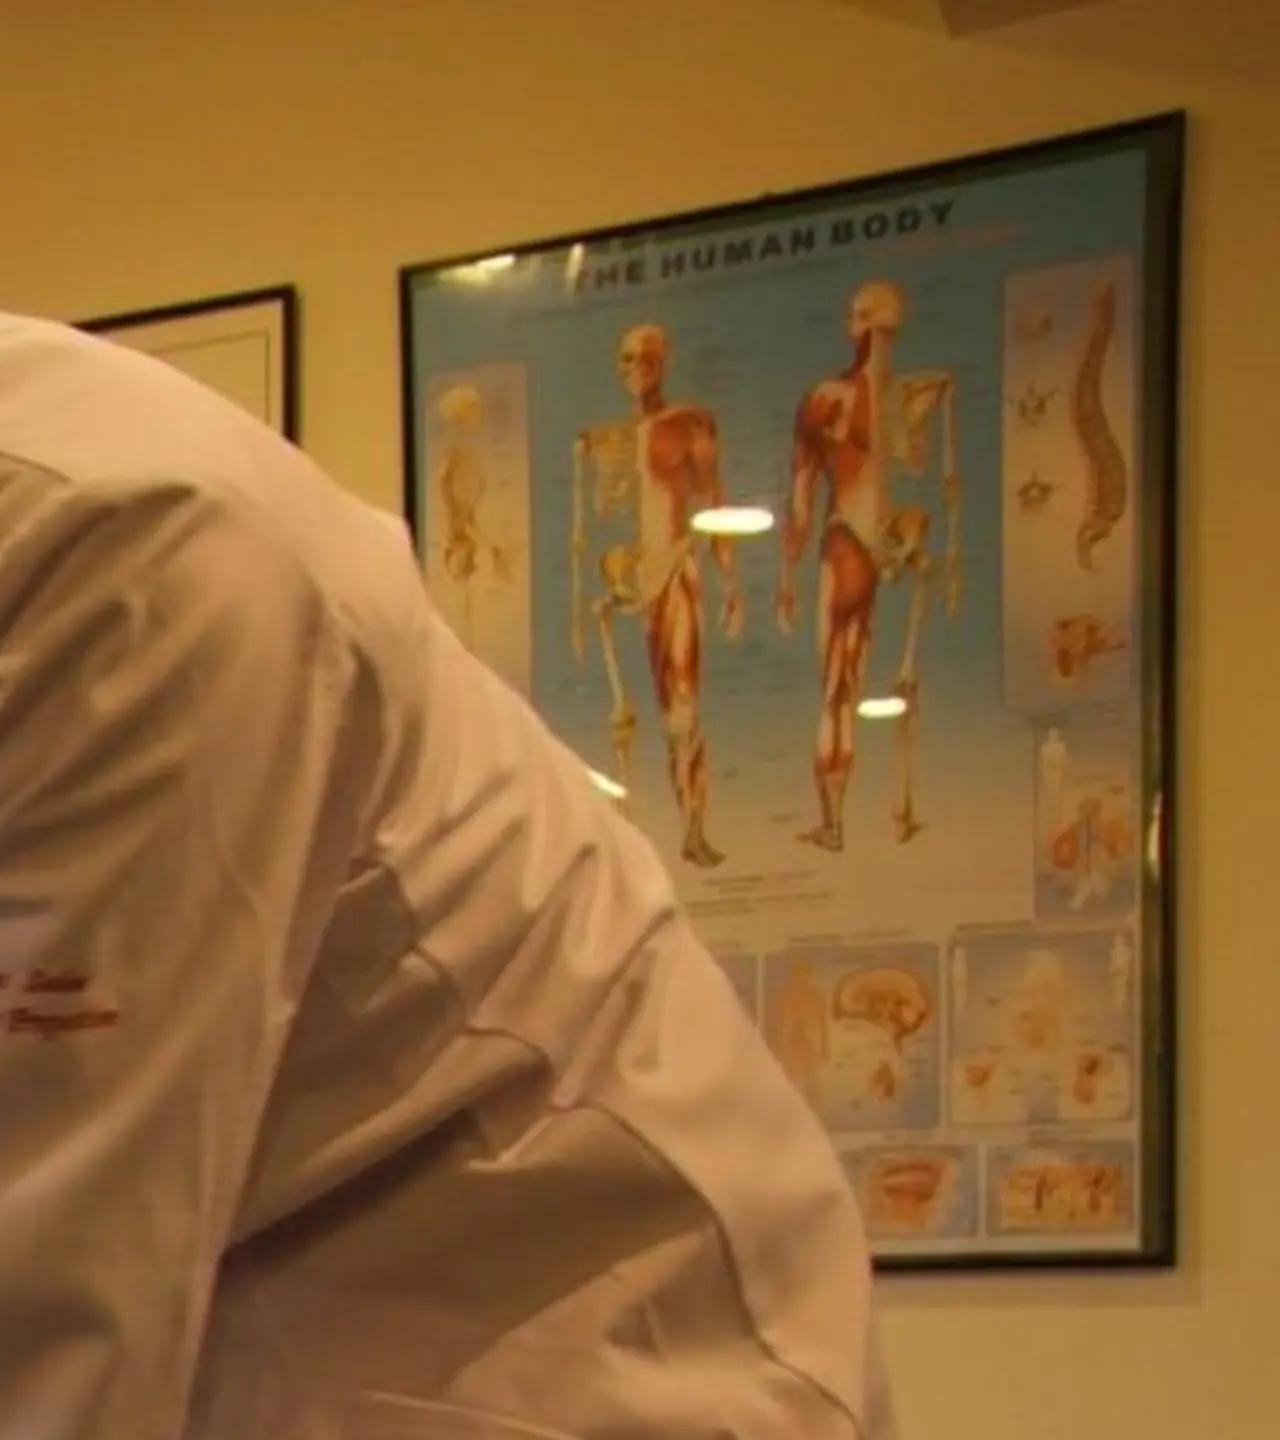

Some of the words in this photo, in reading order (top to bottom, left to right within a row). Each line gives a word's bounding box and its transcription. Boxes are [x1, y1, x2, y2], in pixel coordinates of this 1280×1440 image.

[574, 259, 646, 292] THE
[659, 226, 815, 279] HUMAN
[831, 201, 955, 246] BODY
